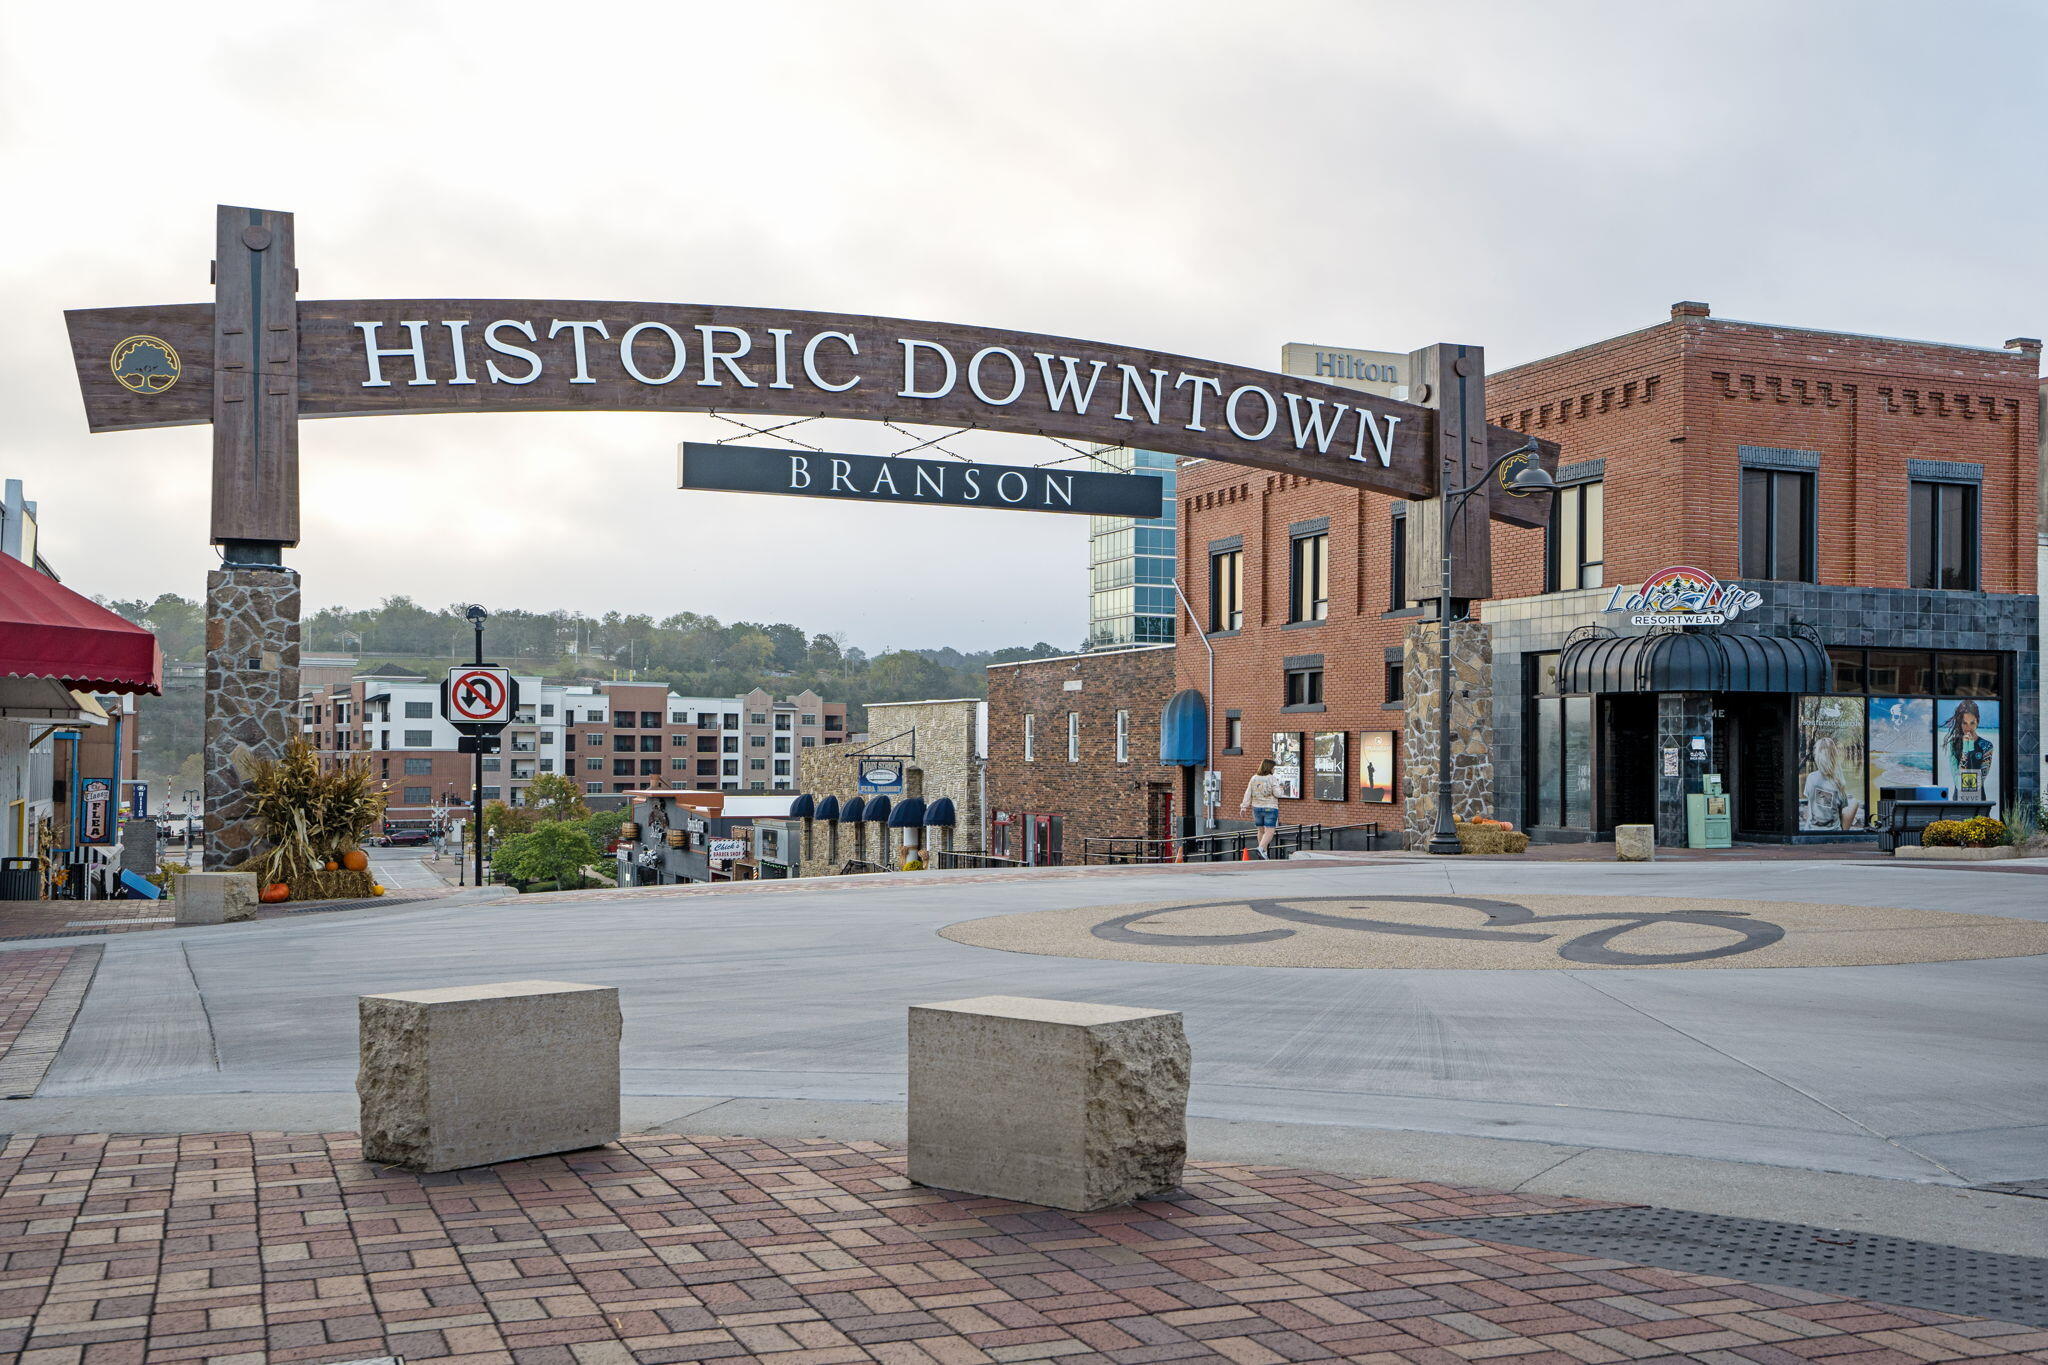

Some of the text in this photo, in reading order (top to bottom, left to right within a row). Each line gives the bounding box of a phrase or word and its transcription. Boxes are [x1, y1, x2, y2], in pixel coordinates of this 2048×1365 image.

[1315, 351, 1398, 383] Hilton
[354, 318, 1401, 468] HISTORIC DOWNTOWN
[788, 455, 1075, 506] BRANSON
[1601, 582, 1764, 621] Lake Life
[1635, 615, 1720, 625] RESORTWEAR
[84, 791, 109, 801] Classy
[91, 802, 101, 836] FLEA
[714, 842, 740, 852] Chick's
